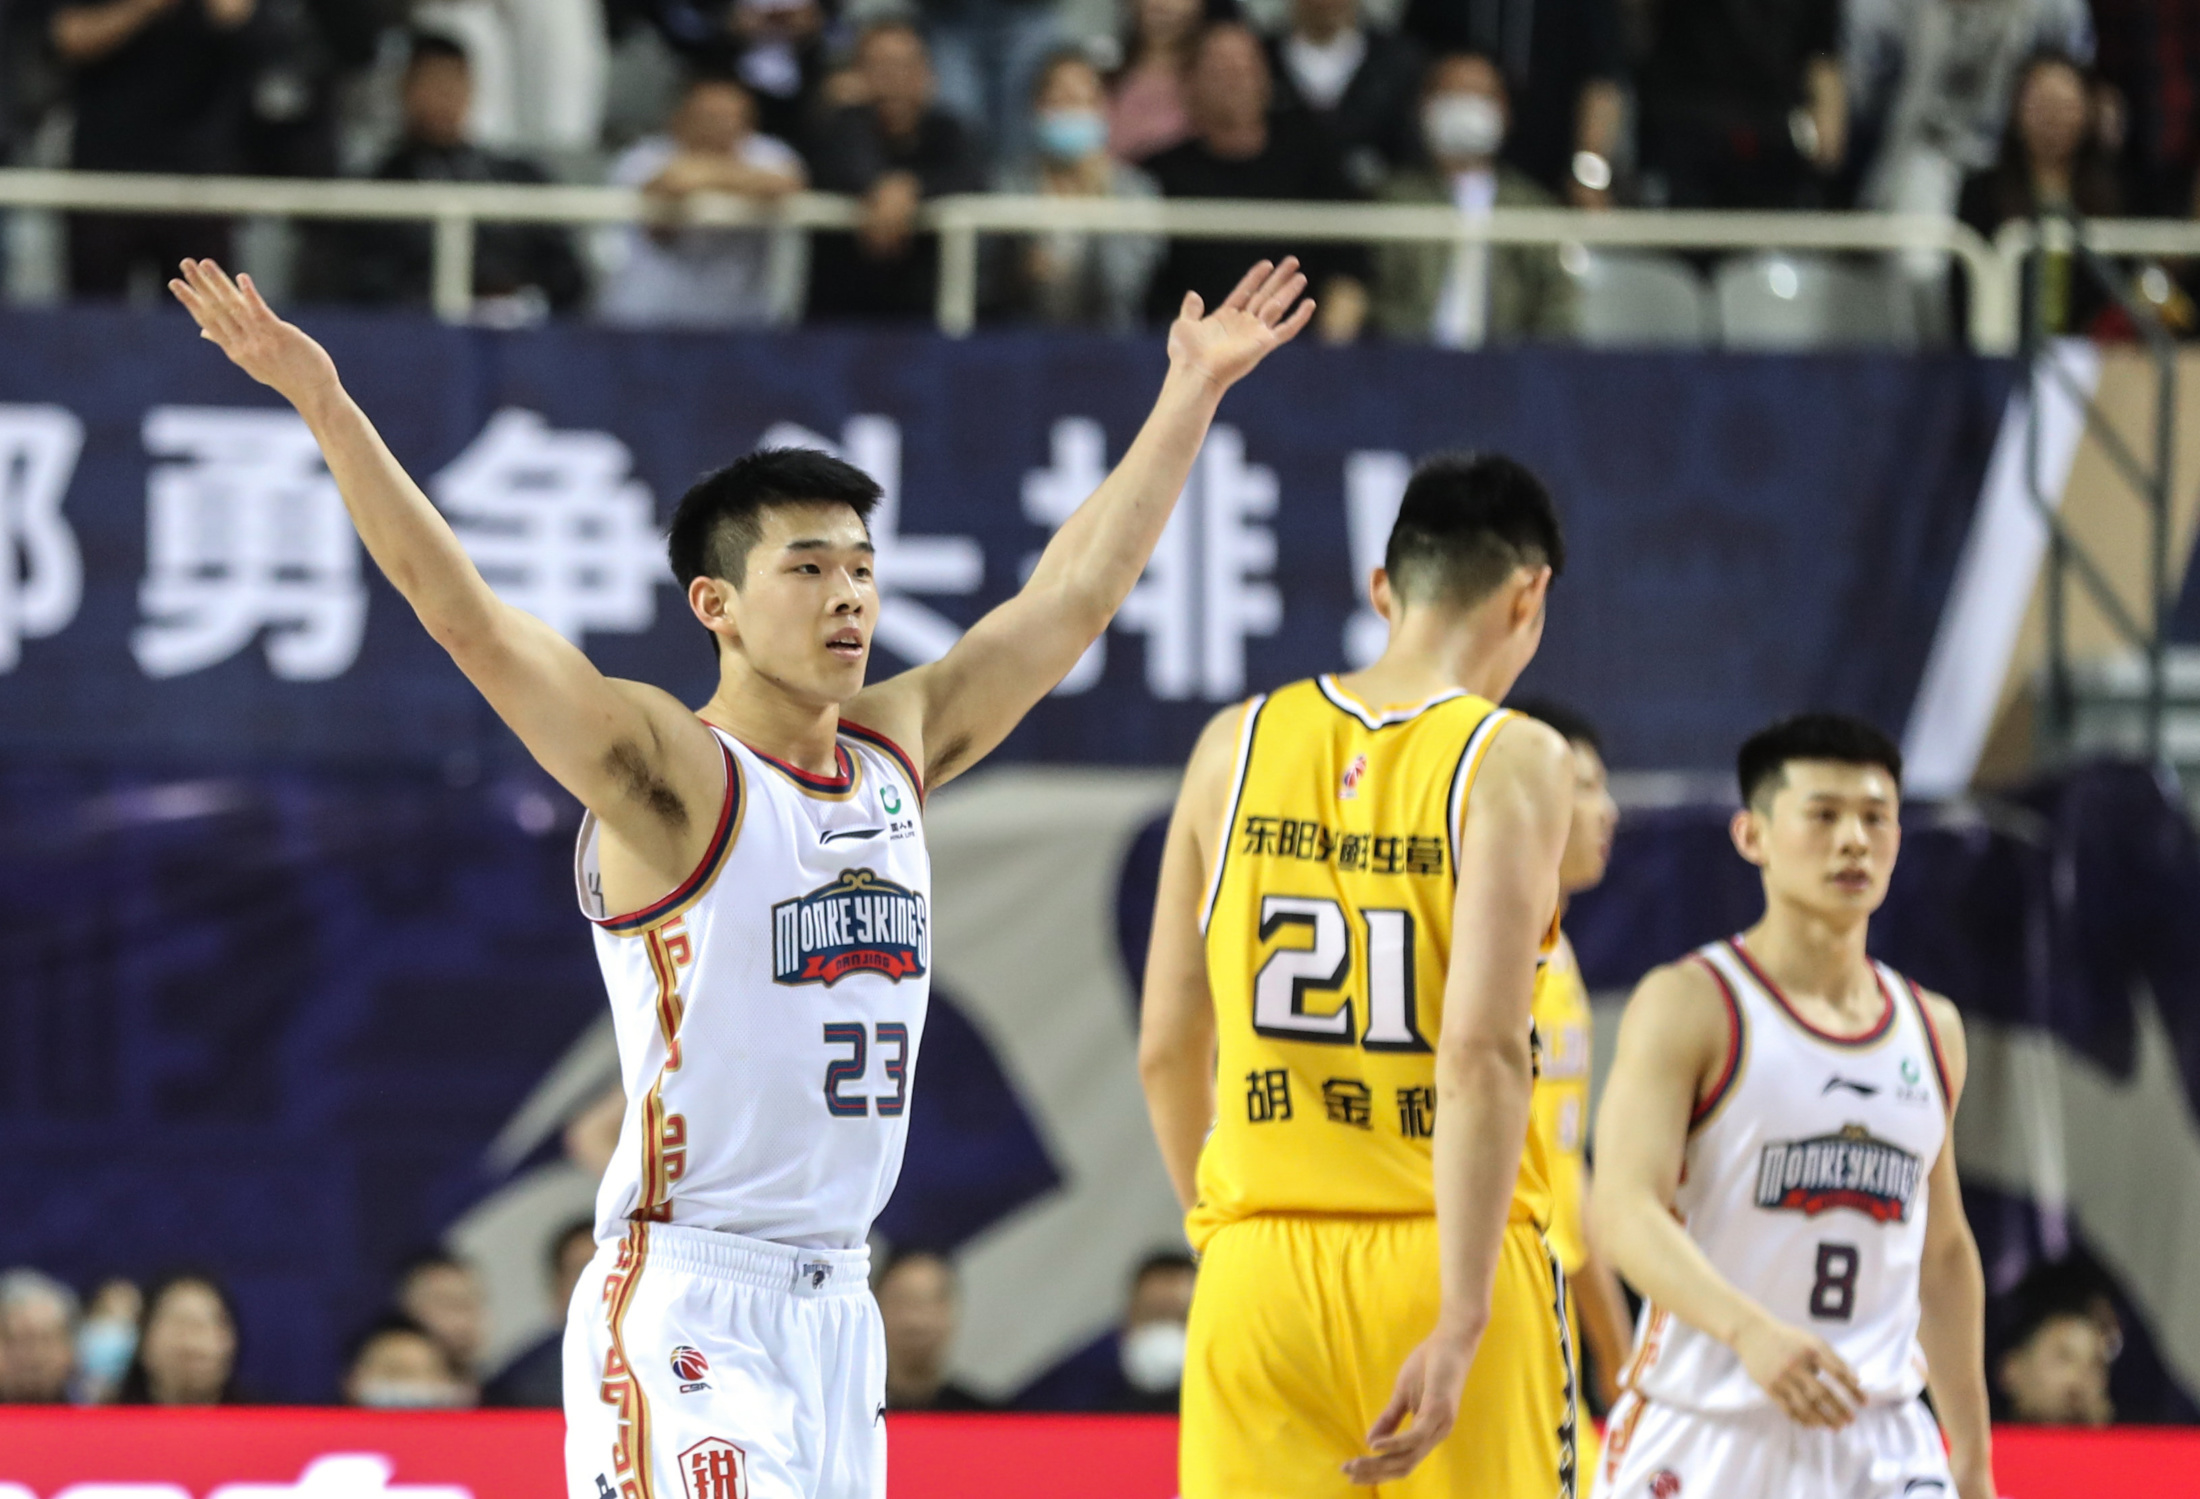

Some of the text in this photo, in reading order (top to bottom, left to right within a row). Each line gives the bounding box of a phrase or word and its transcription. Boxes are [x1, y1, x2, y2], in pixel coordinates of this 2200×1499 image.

[776, 896, 927, 977] MONKEYKINGS
[835, 954, 890, 971] NANJING
[1253, 895, 1434, 1053] 21
[823, 1022, 909, 1118] 23
[1809, 1242, 1859, 1321] 8
[679, 1382, 713, 1394] CBA
